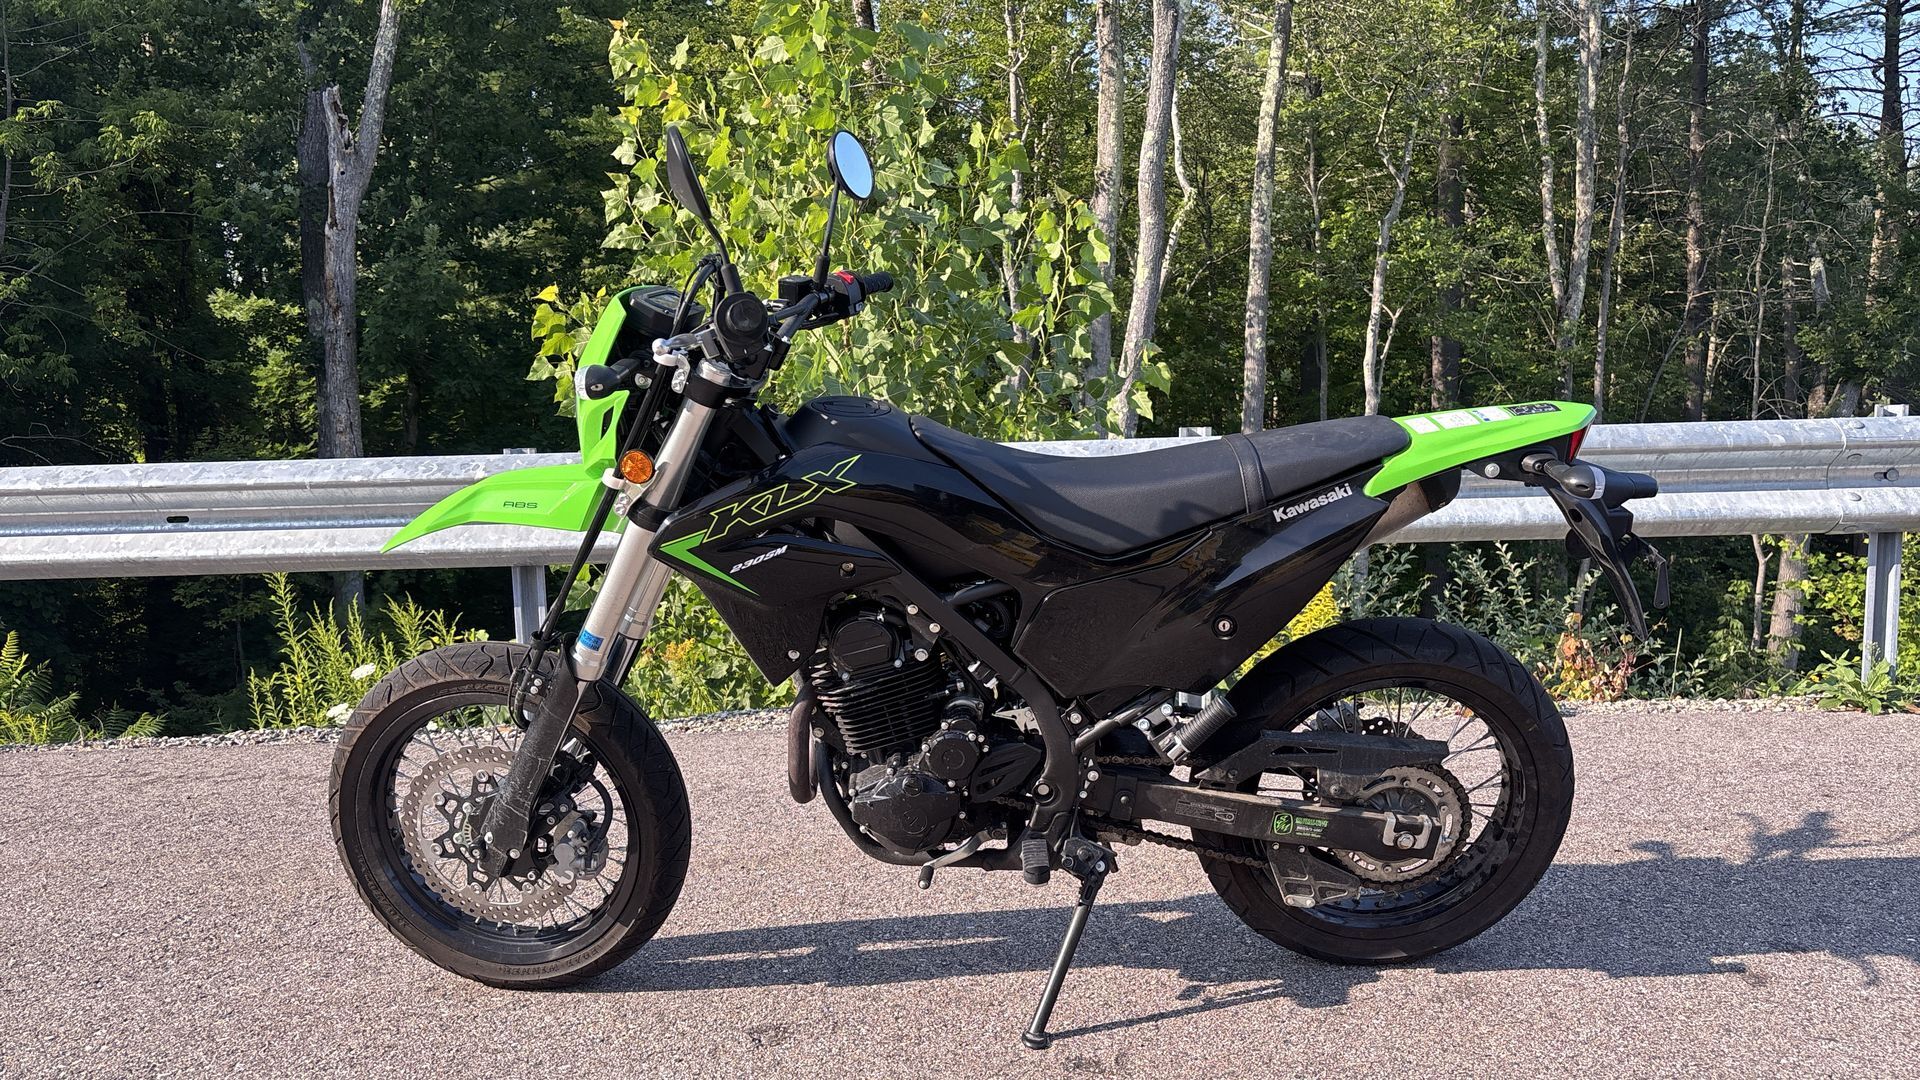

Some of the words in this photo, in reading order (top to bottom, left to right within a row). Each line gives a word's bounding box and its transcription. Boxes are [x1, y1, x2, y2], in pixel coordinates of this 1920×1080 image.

[503, 501, 538, 509] ABS
[702, 454, 862, 543] KLX
[1272, 483, 1353, 523] Kawasaki
[729, 545, 789, 574] 230SM
